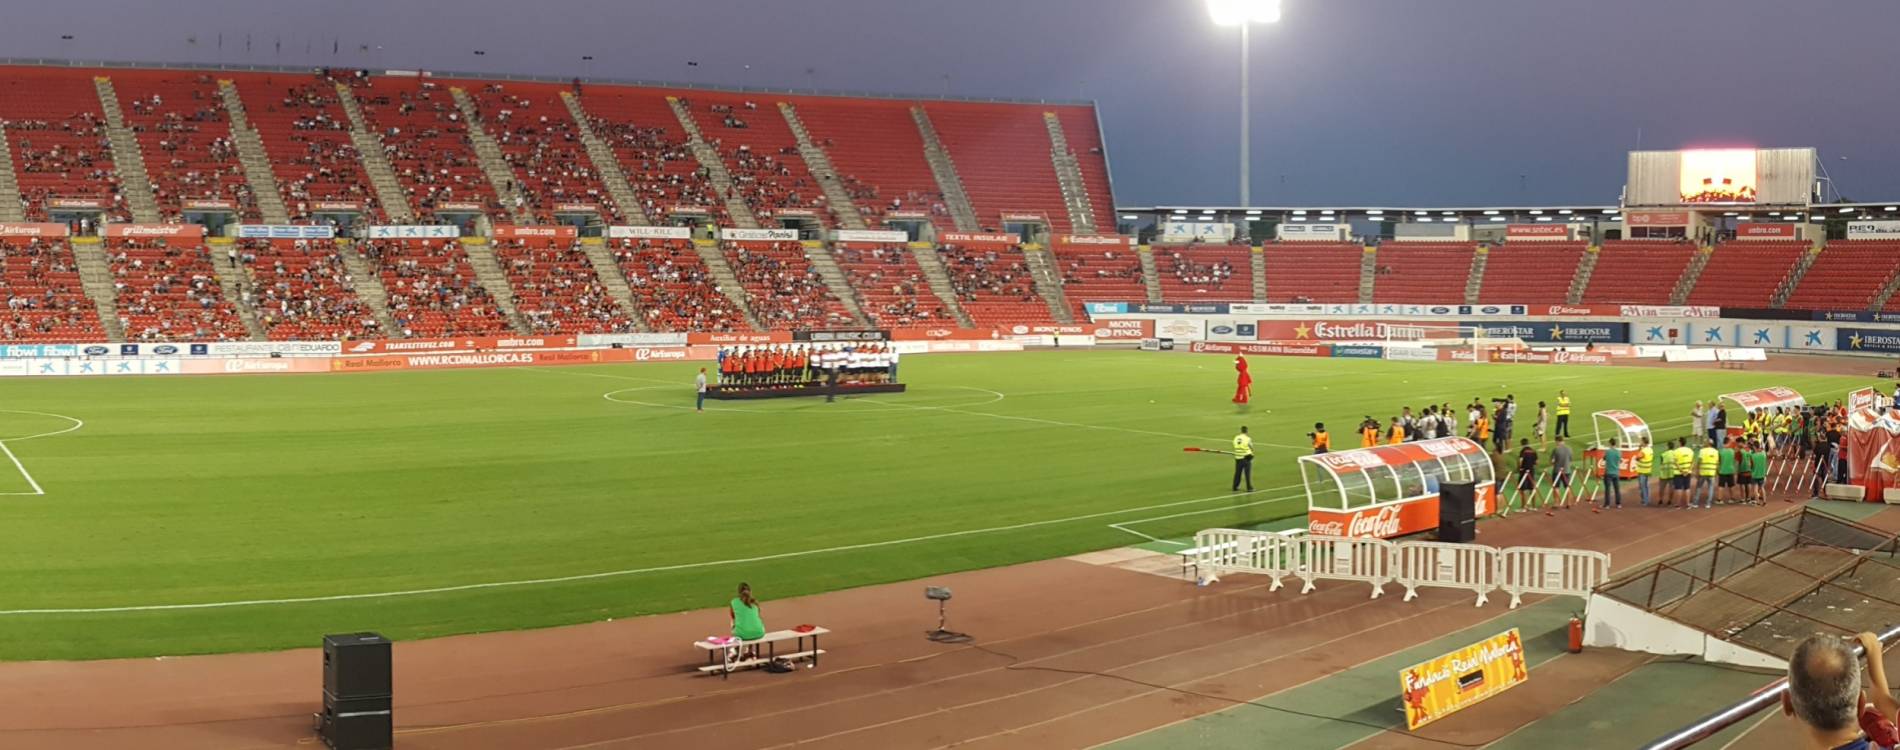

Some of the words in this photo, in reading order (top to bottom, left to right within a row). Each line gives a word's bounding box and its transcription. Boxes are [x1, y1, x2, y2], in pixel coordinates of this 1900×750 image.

[1314, 321, 1374, 338] Estrella
[497, 338, 544, 347] umbro.com
[1864, 335, 1900, 345] IBEROSTA
[408, 354, 533, 366] WWW.RCDMALLORCA.ES
[1451, 654, 1479, 673] Real
